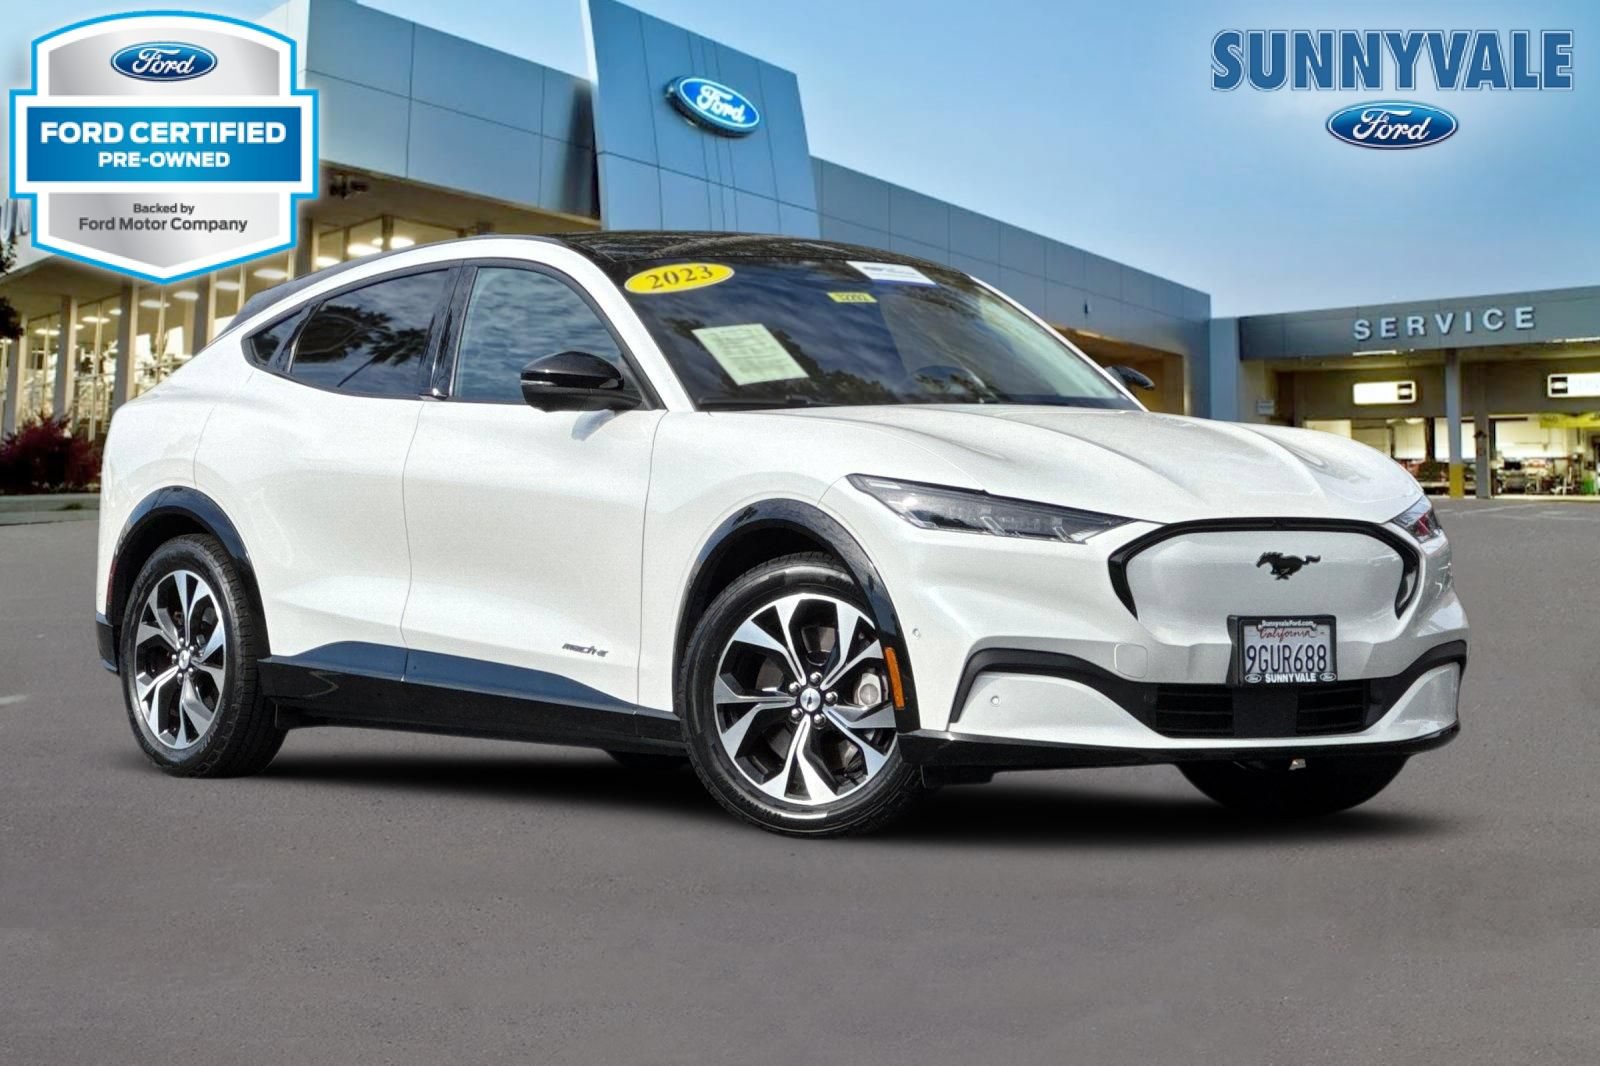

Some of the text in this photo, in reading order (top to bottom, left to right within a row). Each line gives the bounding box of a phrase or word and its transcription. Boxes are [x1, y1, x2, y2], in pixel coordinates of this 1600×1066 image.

[696, 84, 746, 123] Ford
[645, 264, 713, 290] 2023
[1353, 306, 1535, 341] SERVICE
[1260, 627, 1316, 642] California
[1246, 644, 1328, 673] 9GUR688
[1265, 672, 1317, 683] SUNNYVALE
